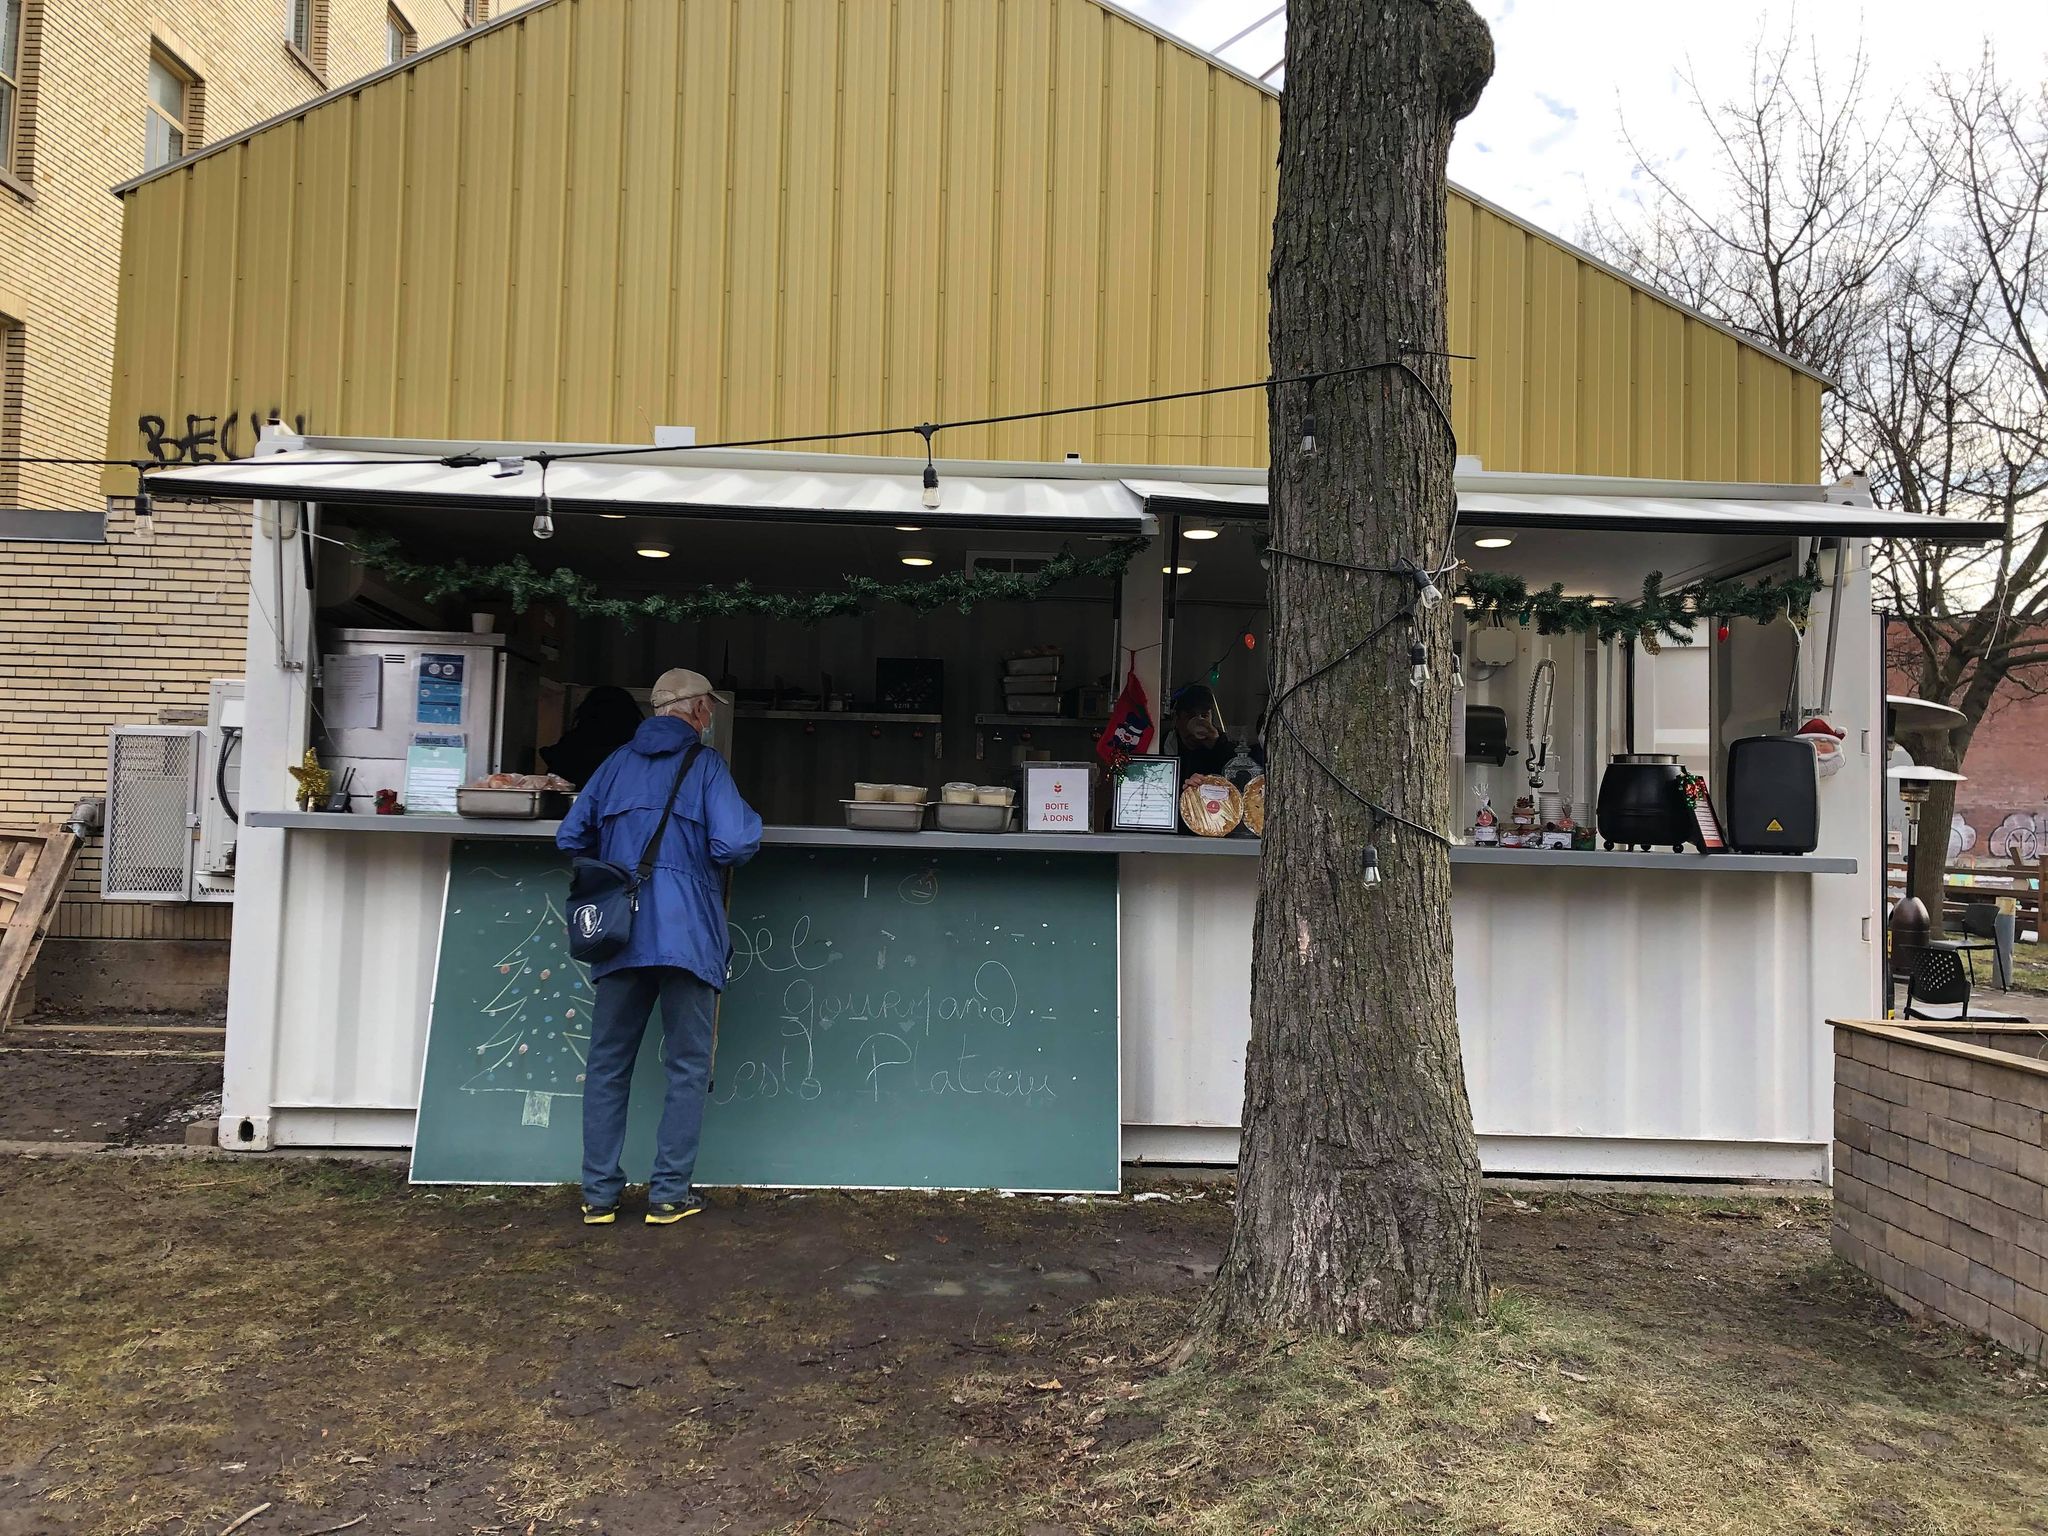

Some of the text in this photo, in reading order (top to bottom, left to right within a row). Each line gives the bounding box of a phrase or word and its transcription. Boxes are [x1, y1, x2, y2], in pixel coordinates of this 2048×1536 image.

[1045, 802, 1069, 811] BOITE
[1042, 812, 1074, 822] À DONS
